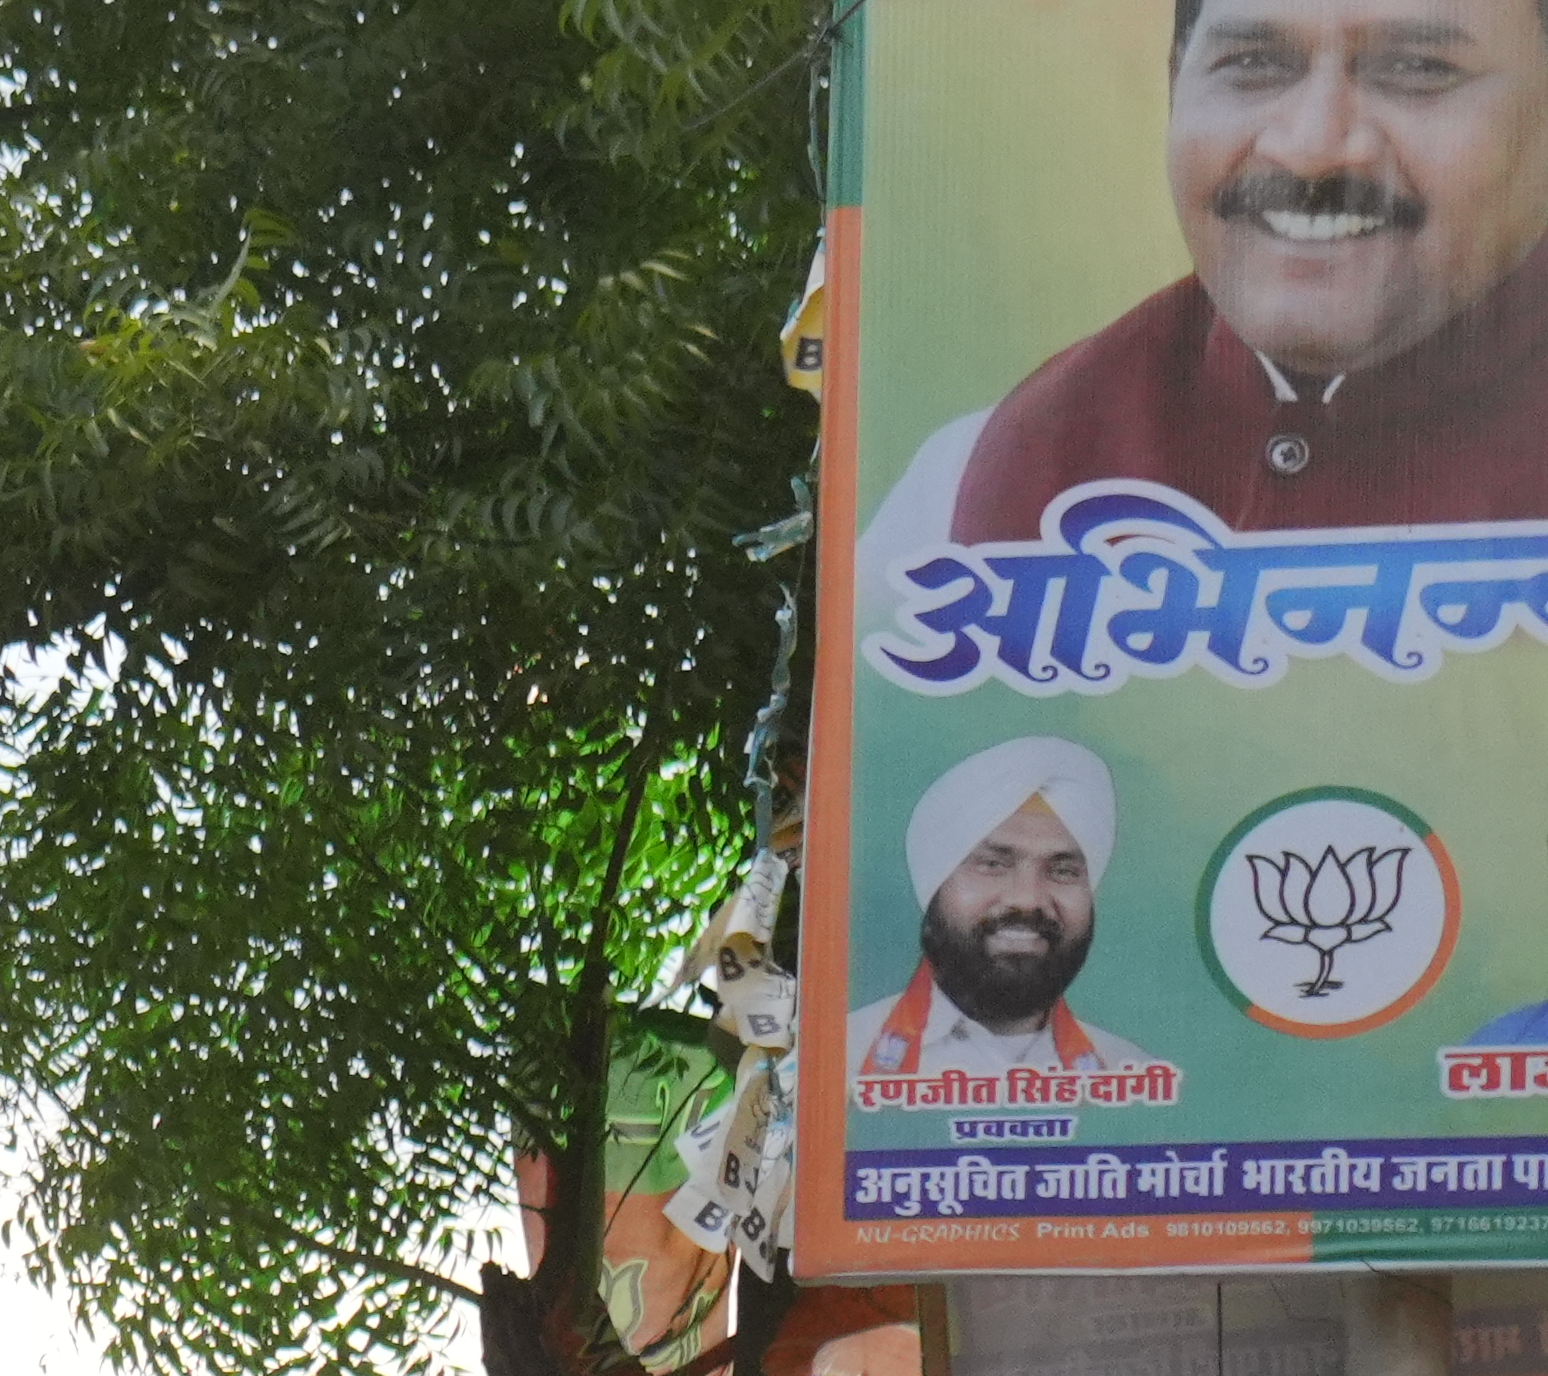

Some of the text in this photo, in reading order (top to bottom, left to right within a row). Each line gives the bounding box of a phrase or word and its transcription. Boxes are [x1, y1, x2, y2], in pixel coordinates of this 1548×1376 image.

[880, 500, 1548, 683] अभिनन्
[857, 1064, 1176, 1106] रणजीत सिंह दांगी
[955, 1118, 1072, 1140] प्रवक्ता
[856, 1155, 1030, 1216] अनुसूचित
[1035, 1153, 1131, 1200] जाति
[1135, 1149, 1228, 1198] मोर्चा
[1242, 1147, 1384, 1196] भारतीय
[1391, 1155, 1506, 1193] जनता
[857, 1222, 1021, 1243] NU-GRAPHICS
[1037, 1221, 1095, 1239] Print
[1101, 1220, 1149, 1239] Ads
